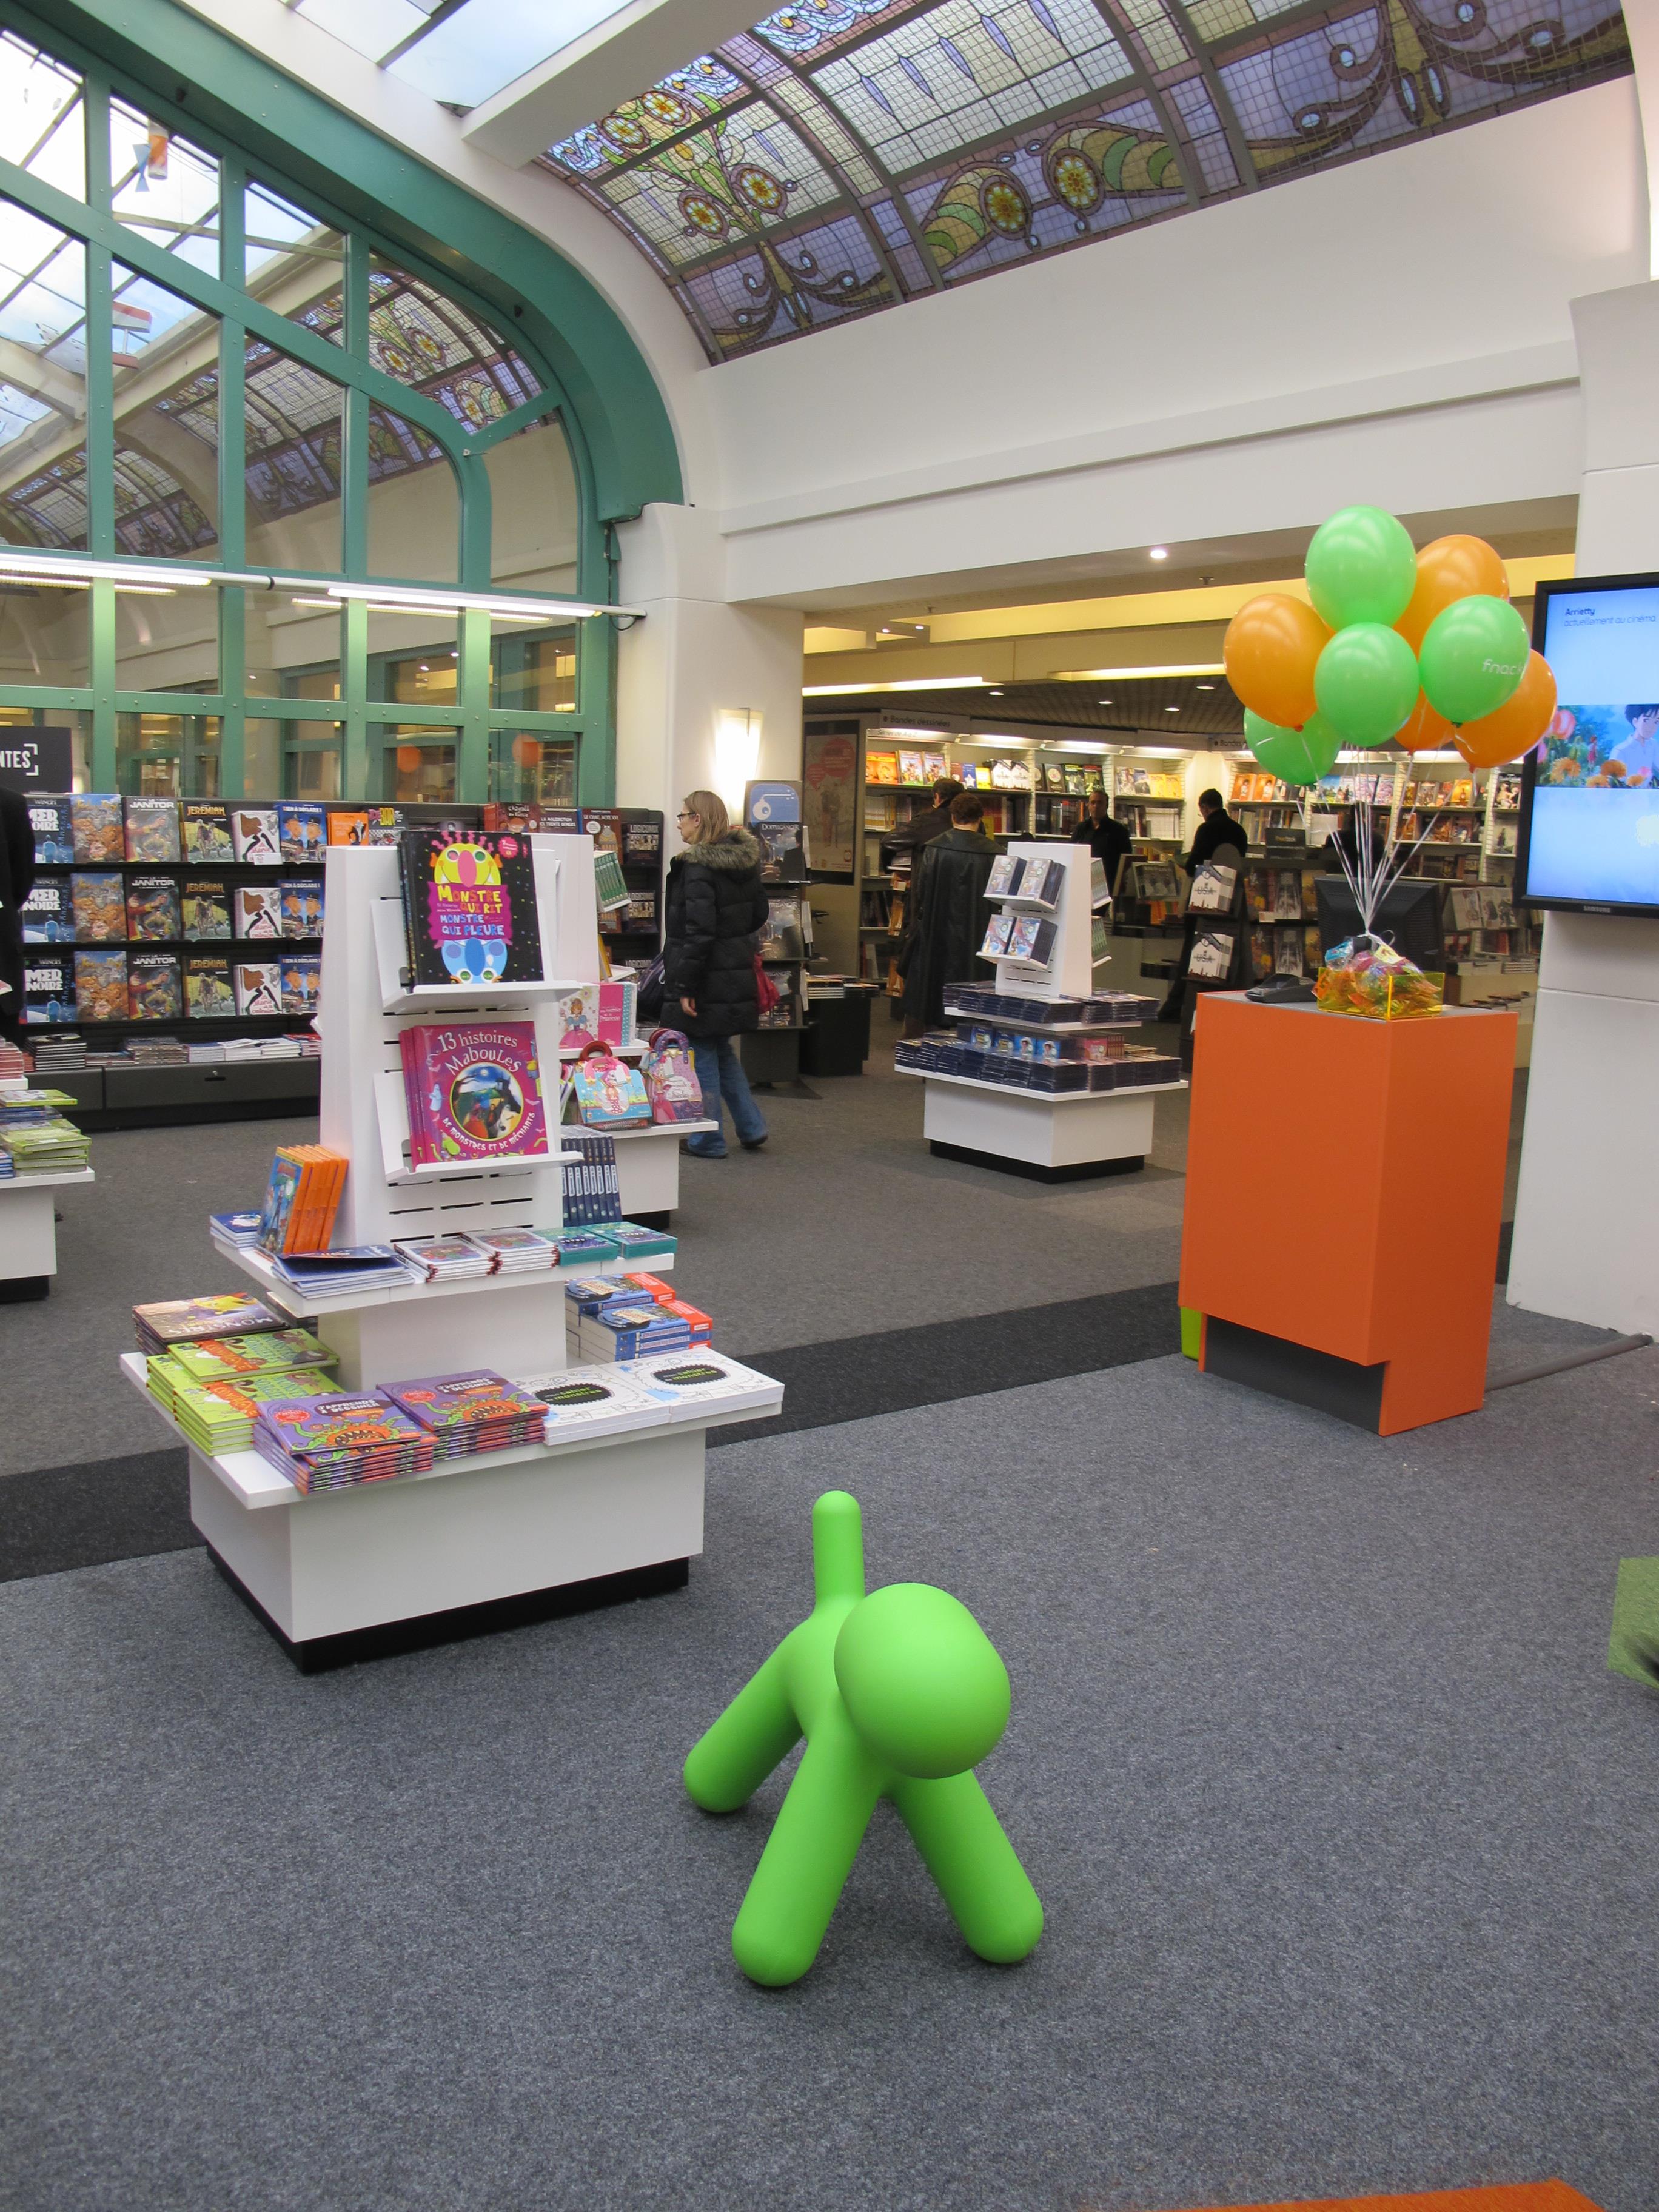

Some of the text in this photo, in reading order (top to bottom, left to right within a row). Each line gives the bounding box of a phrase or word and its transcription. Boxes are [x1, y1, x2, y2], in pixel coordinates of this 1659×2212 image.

[1564, 617, 1613, 626] actuellement
[890, 716, 916, 725] Bandes
[187, 805, 226, 817] JEREMIAH
[32, 820, 59, 831] OIRE
[186, 883, 225, 893] JEREMIAH
[437, 885, 502, 902] MONSTRE
[461, 902, 481, 913] QUI
[484, 903, 503, 913] RIT
[440, 914, 484, 923] MONSTRE
[441, 924, 504, 936] QUI PLEURE
[190, 959, 228, 970] JEREMIAH
[25, 969, 62, 982] MER
[25, 981, 63, 991] NOIRE
[438, 1030, 518, 1052] 13 histoires
[450, 1128, 486, 1151] MONSTRES
[672, 1369, 717, 1381] monstres
[554, 1389, 602, 1401] monstres
[317, 1399, 376, 1411] J'APPRENDS
